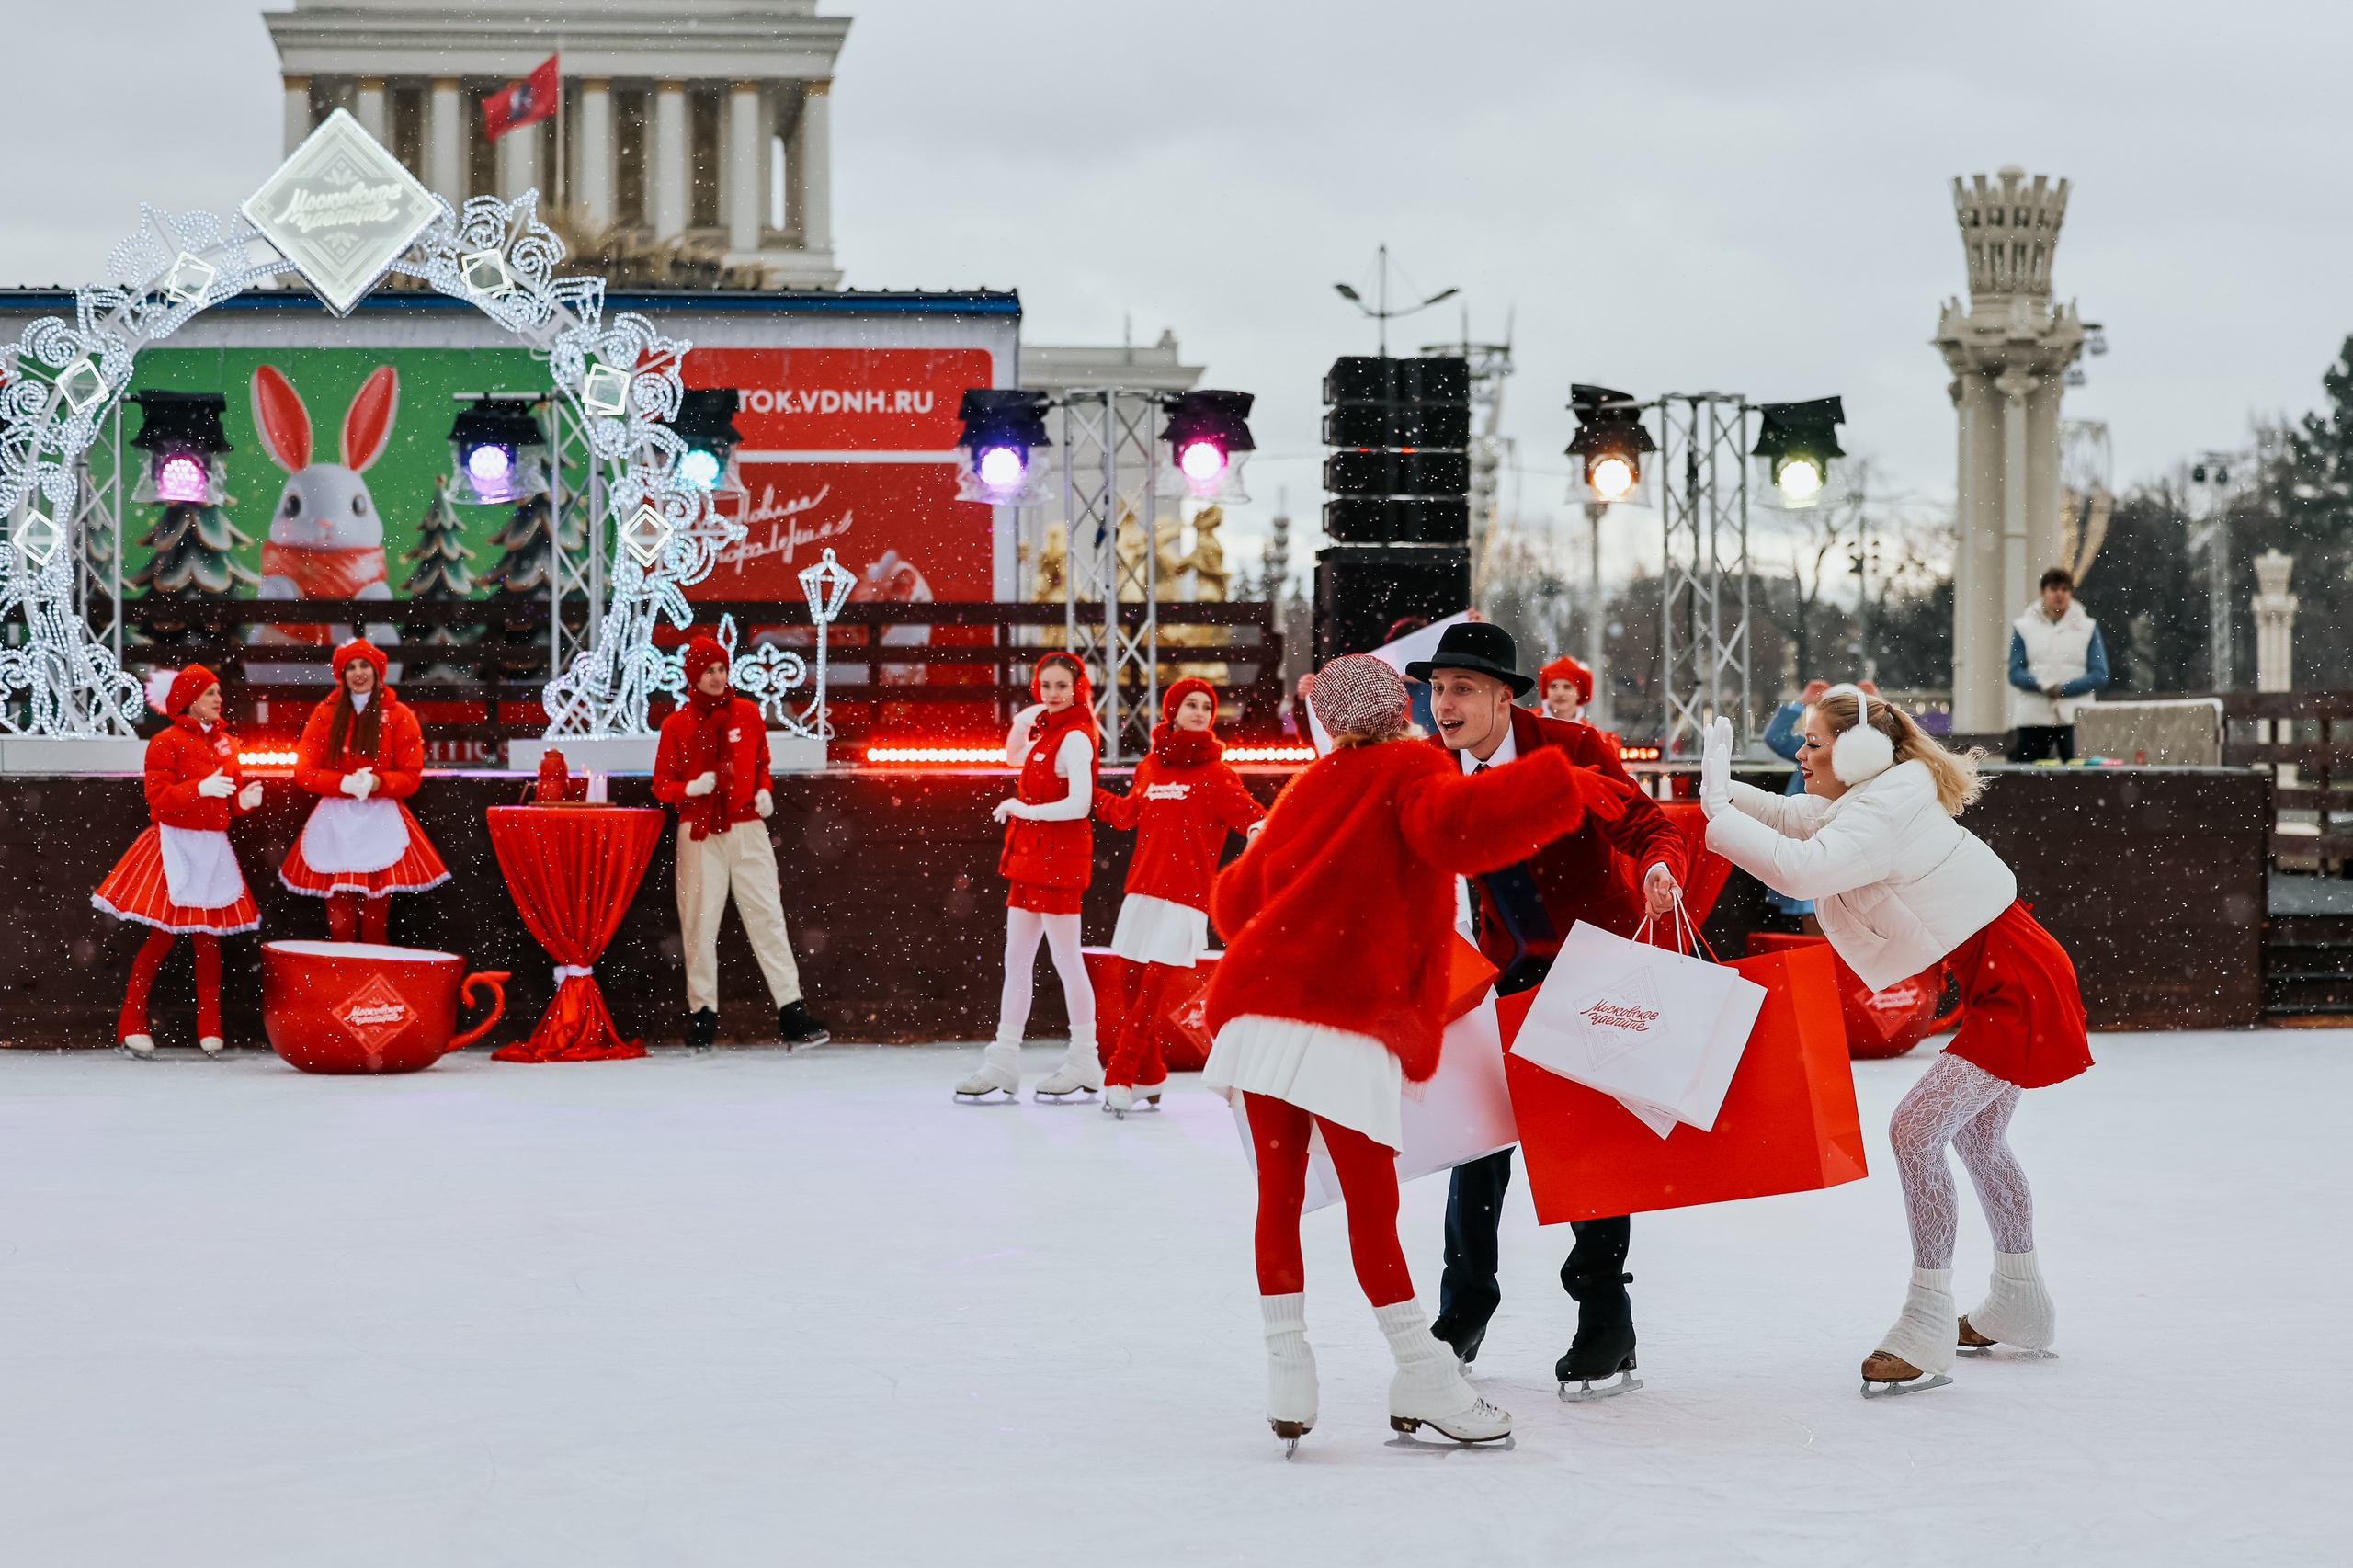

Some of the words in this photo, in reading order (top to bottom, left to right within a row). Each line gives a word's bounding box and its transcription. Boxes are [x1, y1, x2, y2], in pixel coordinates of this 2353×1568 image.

[274, 180, 404, 225] Московское
[737, 390, 934, 414] TOK.VDNH.RU
[1580, 998, 1659, 1020] Московское
